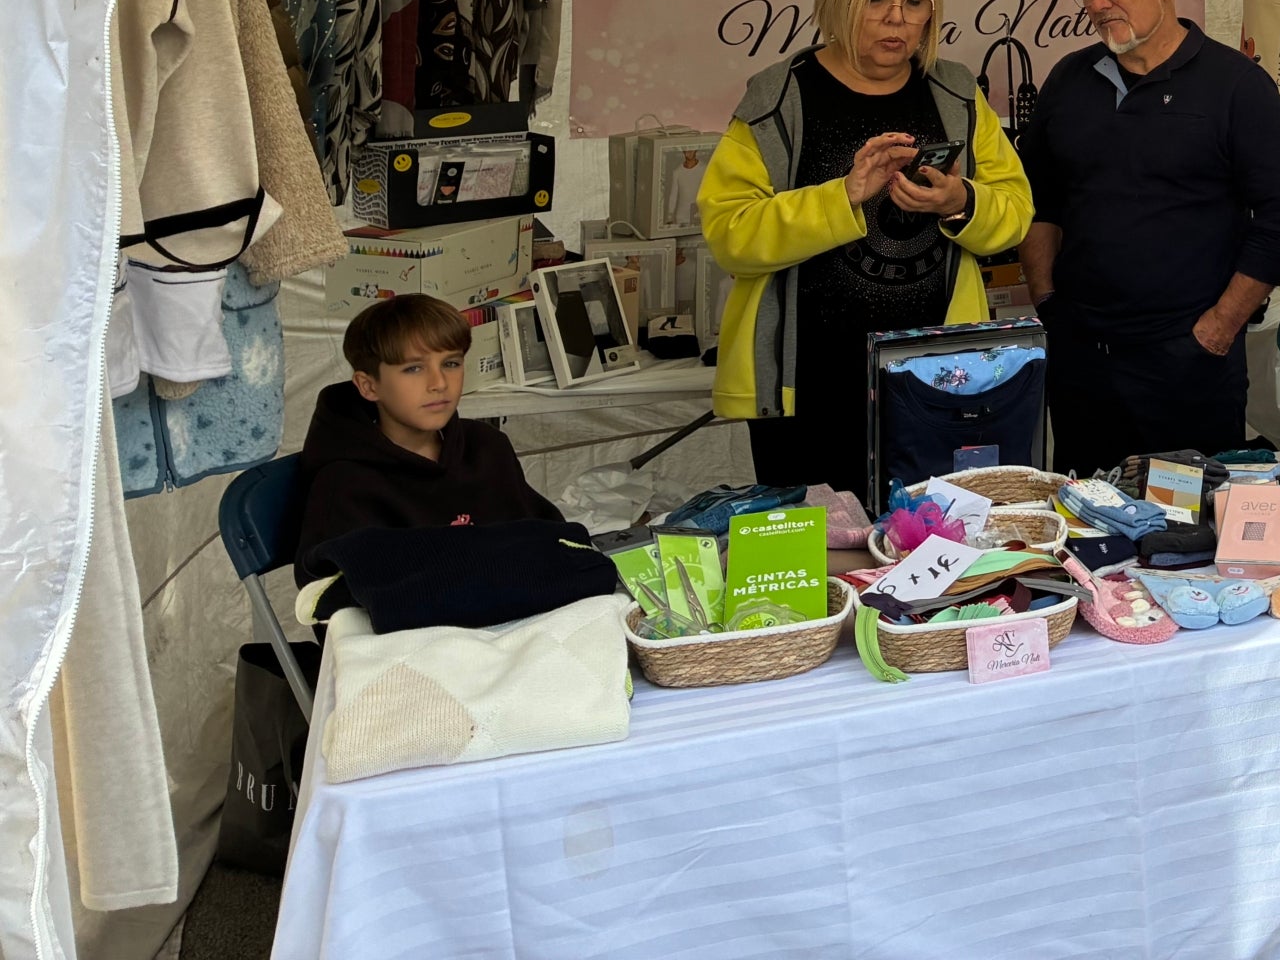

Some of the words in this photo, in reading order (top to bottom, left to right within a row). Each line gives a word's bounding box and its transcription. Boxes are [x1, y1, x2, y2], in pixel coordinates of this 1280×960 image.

[752, 520, 815, 533] castelltort
[758, 527, 805, 537] castelltort.com
[746, 569, 807, 584] CINTAS
[733, 578, 820, 597] MÉTRICAS
[986, 659, 1020, 671] Merceria
[1021, 653, 1041, 665] Nati
